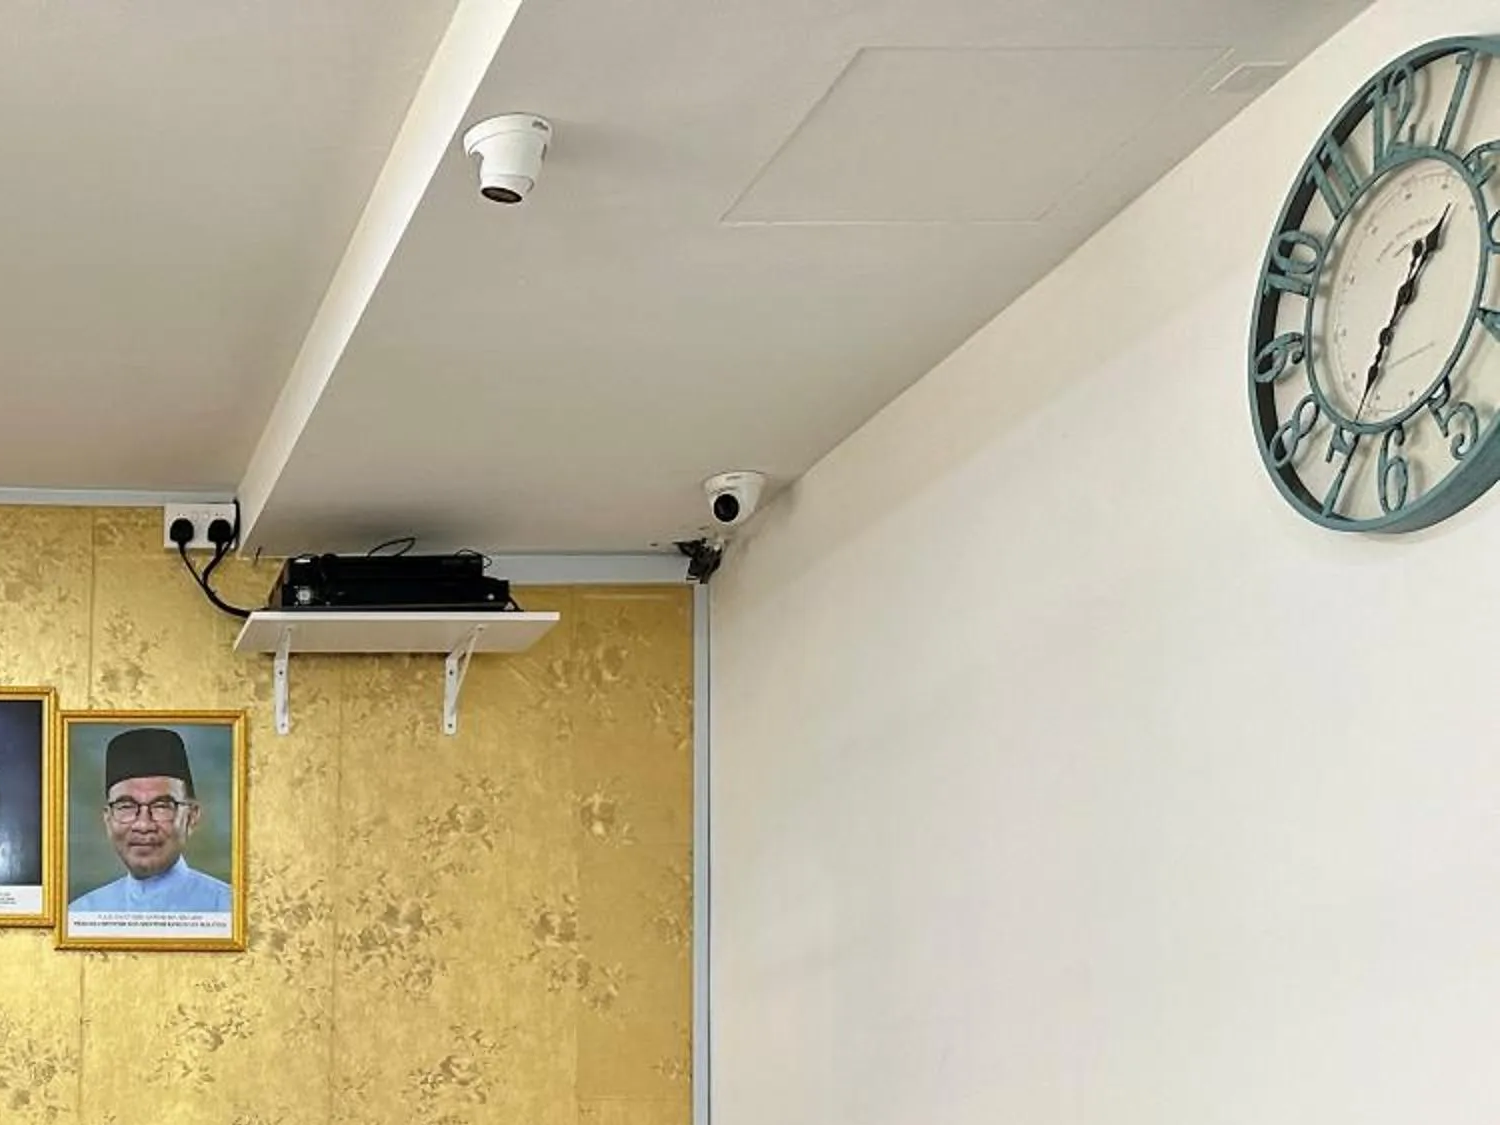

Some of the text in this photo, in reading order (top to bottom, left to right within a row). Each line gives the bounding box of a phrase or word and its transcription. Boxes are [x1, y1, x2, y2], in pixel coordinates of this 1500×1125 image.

[1366, 66, 1418, 169] 12
[1436, 50, 1476, 151] 1
[1304, 137, 1360, 221] 11
[1265, 230, 1324, 297] 10
[1255, 331, 1306, 384] 9
[1269, 393, 1322, 468] 8
[1425, 374, 1479, 461] 5
[1318, 421, 1362, 517] 7
[1377, 422, 1410, 515] 6
